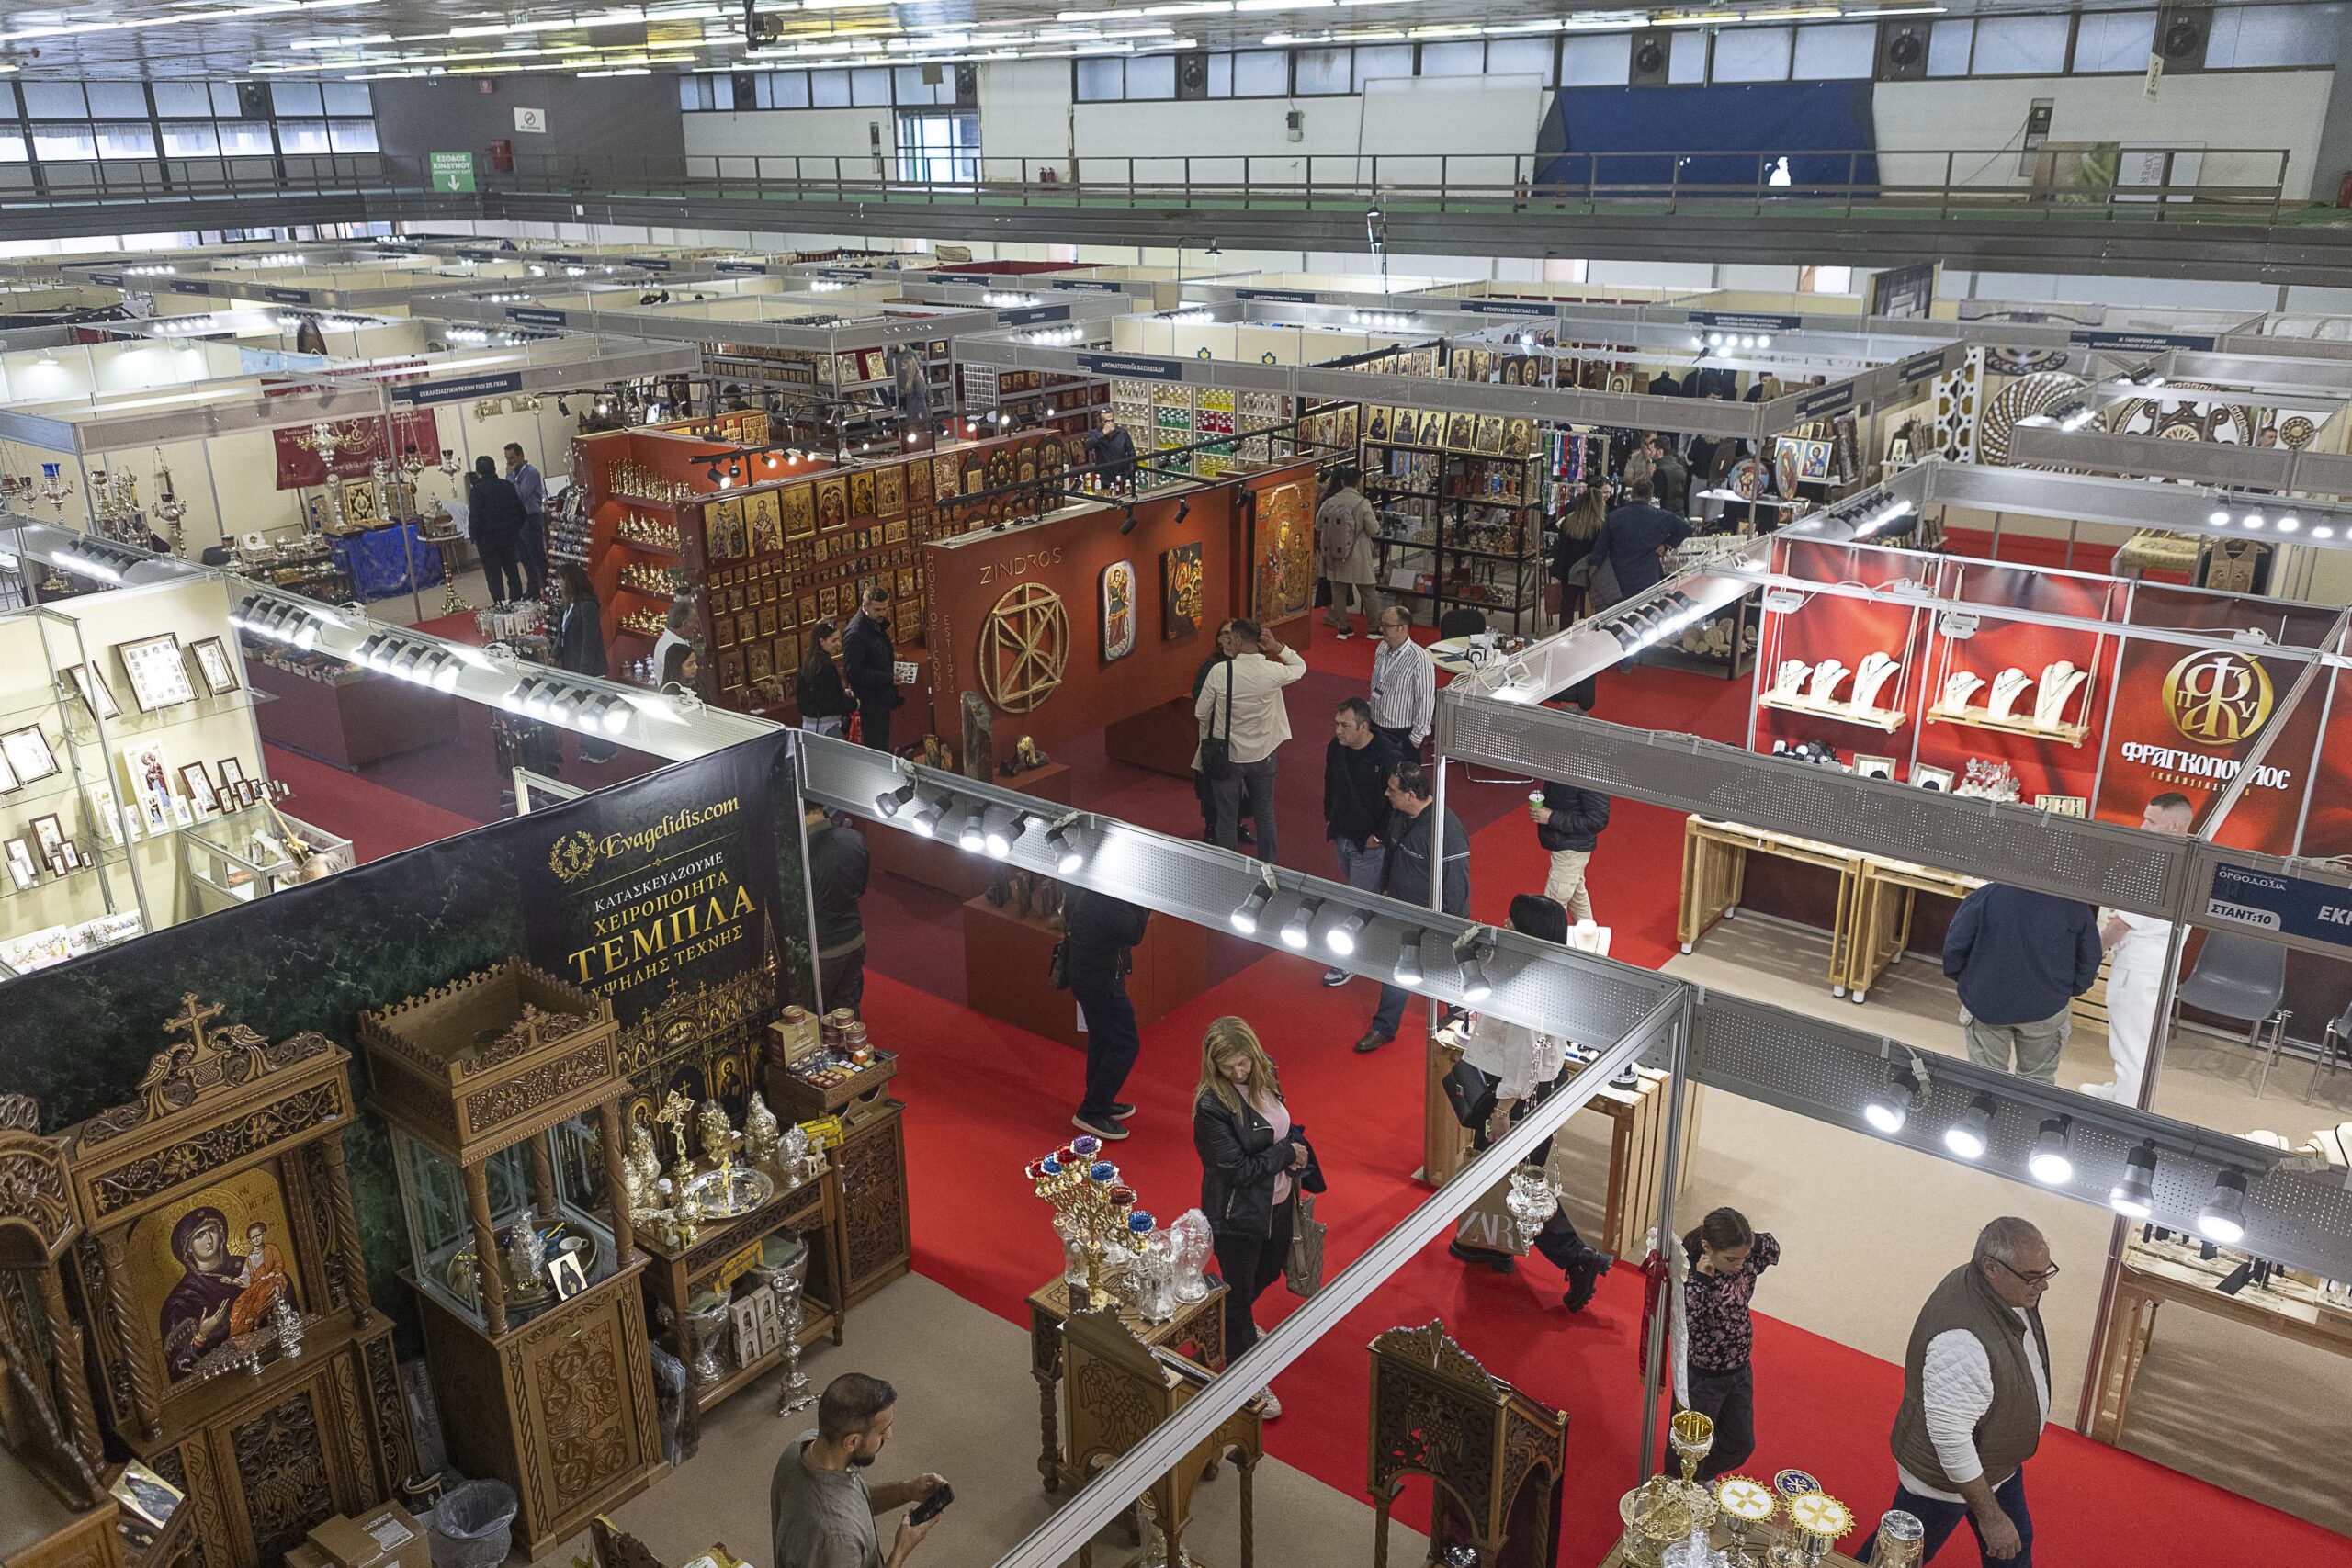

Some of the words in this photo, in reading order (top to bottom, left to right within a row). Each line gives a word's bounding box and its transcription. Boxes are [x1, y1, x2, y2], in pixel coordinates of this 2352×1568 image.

[926, 553, 936, 604] HOUSE
[979, 547, 1062, 585] ZINDROS
[930, 613, 938, 633] OF
[599, 796, 740, 858] Evagelidis.com
[594, 852, 724, 913] ΚΑΤΑΣΚΕΥΑΖΟΥΜΕ
[594, 871, 729, 937] ΧΕΙΡΟΠΟΙΗΤΑ
[568, 885, 756, 985] ΤΕΜΠΛΑ
[2211, 903, 2272, 925] ΣΤΑΝΤ:10
[591, 956, 671, 1000] ΥΨΗΛΗΣ
[674, 924, 743, 965] ΤΕΧΝΗΣ
